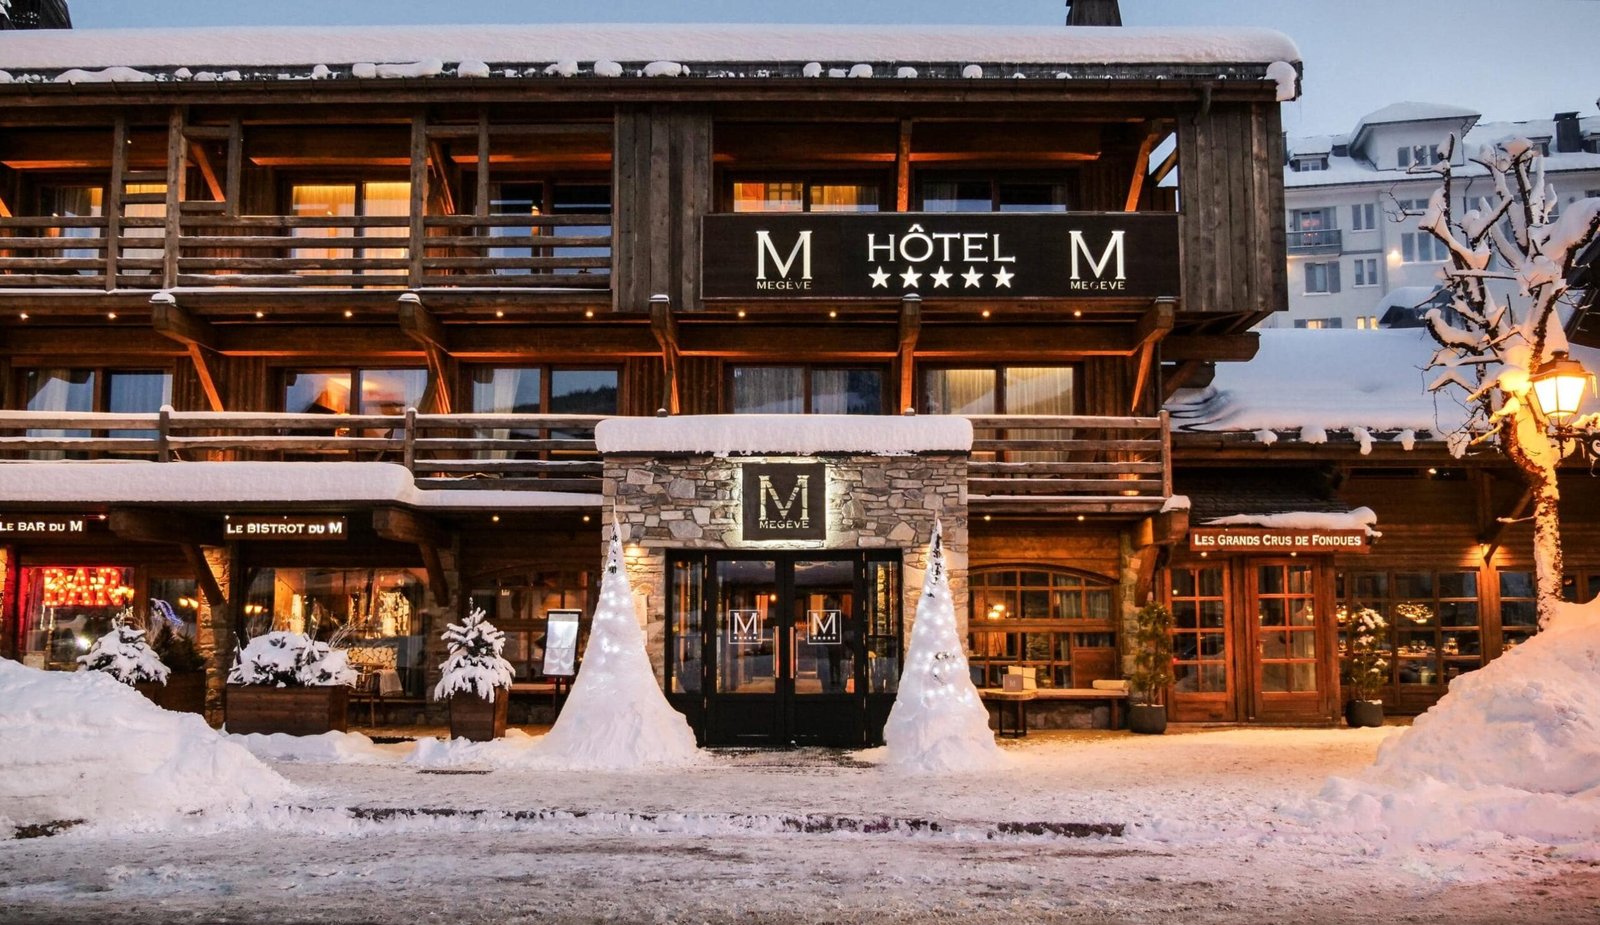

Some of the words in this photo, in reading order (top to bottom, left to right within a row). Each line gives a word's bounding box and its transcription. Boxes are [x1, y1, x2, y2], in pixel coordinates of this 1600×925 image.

[755, 230, 813, 280] M
[867, 223, 1016, 263] HÔTEL
[1068, 230, 1126, 280] M
[758, 474, 810, 520] M
[0, 521, 15, 531] LE
[17, 521, 46, 532] BAR
[48, 523, 66, 532] DU
[69, 520, 83, 532] M
[226, 523, 243, 534] LE
[247, 523, 305, 534] BISTROT
[308, 525, 325, 534] DU
[328, 521, 343, 534] M
[1194, 534, 1215, 546] LES
[1217, 534, 1261, 546] GRANDS
[1262, 534, 1293, 546] CRUS
[1295, 535, 1309, 546] DE
[1312, 534, 1362, 546] FONDUES
[42, 566, 124, 606] BAR
[733, 612, 758, 635] M
[812, 612, 837, 635] M
